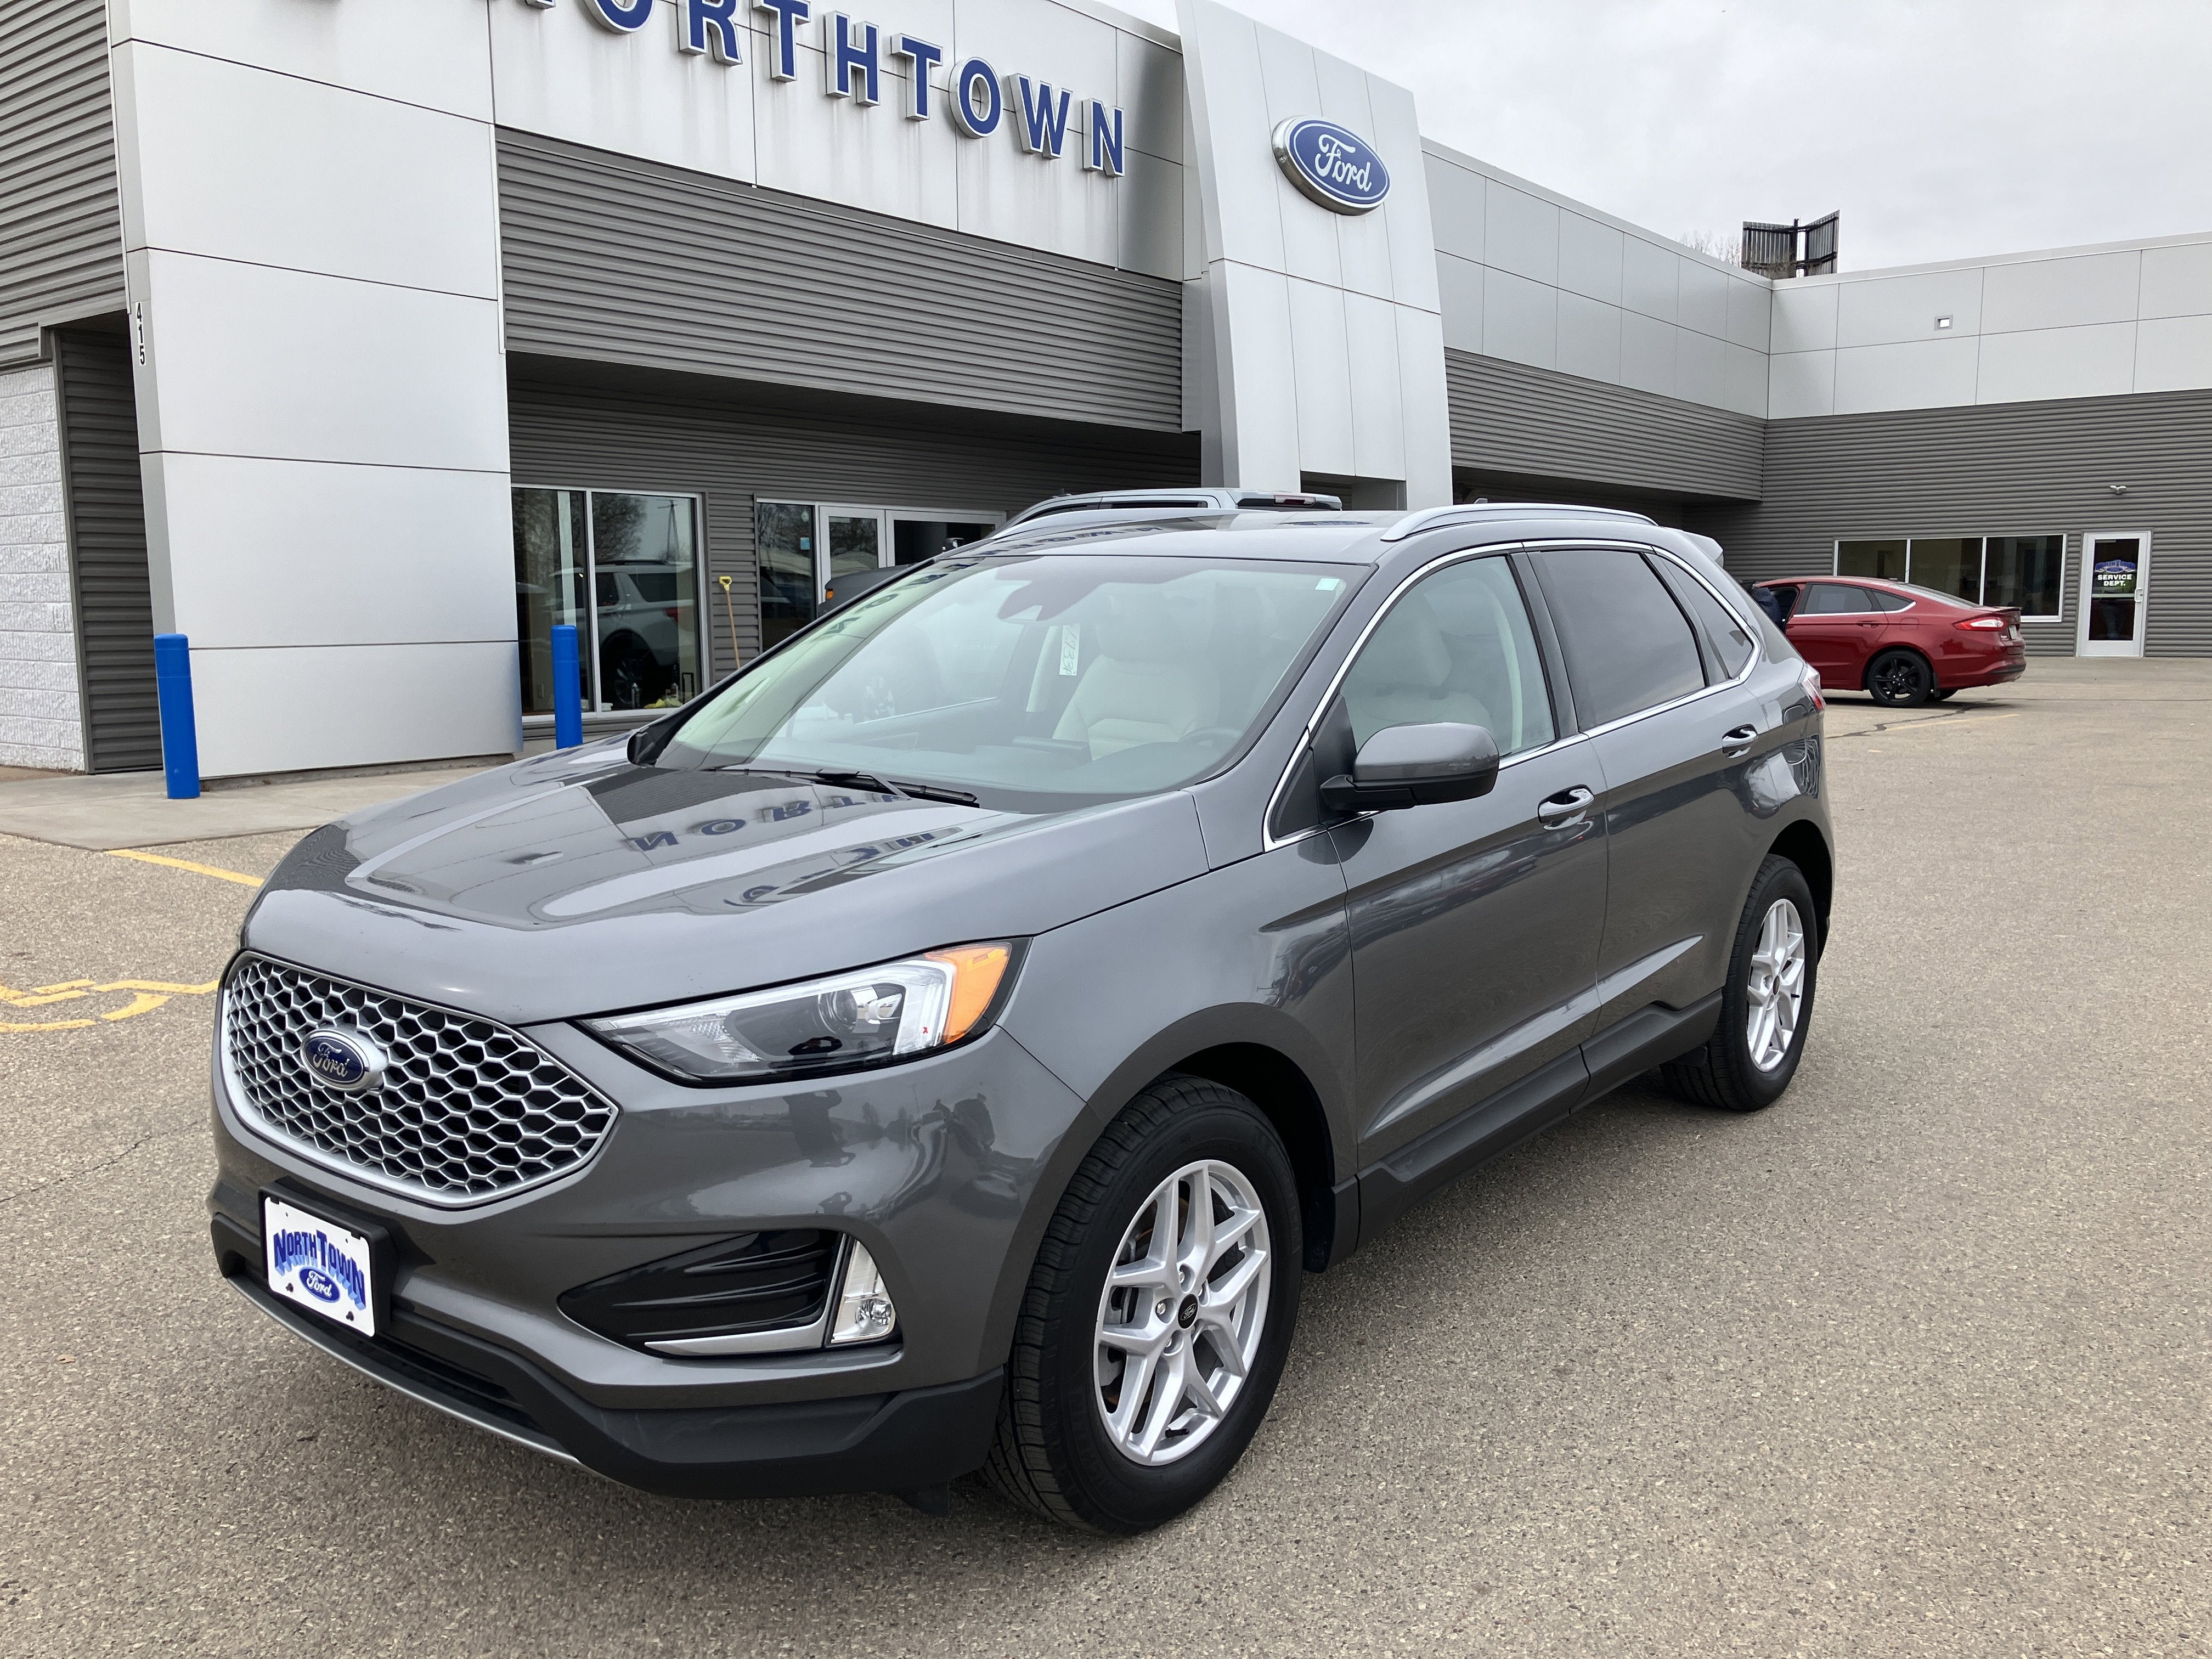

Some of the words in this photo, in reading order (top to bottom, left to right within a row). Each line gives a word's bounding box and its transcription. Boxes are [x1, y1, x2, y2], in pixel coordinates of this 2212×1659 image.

[525, 0, 1126, 178] RTHTOWN
[1314, 134, 1372, 193] Ford
[137, 302, 145, 365] 415
[313, 1042, 351, 1077] Ford
[306, 1270, 333, 1299] Ford
